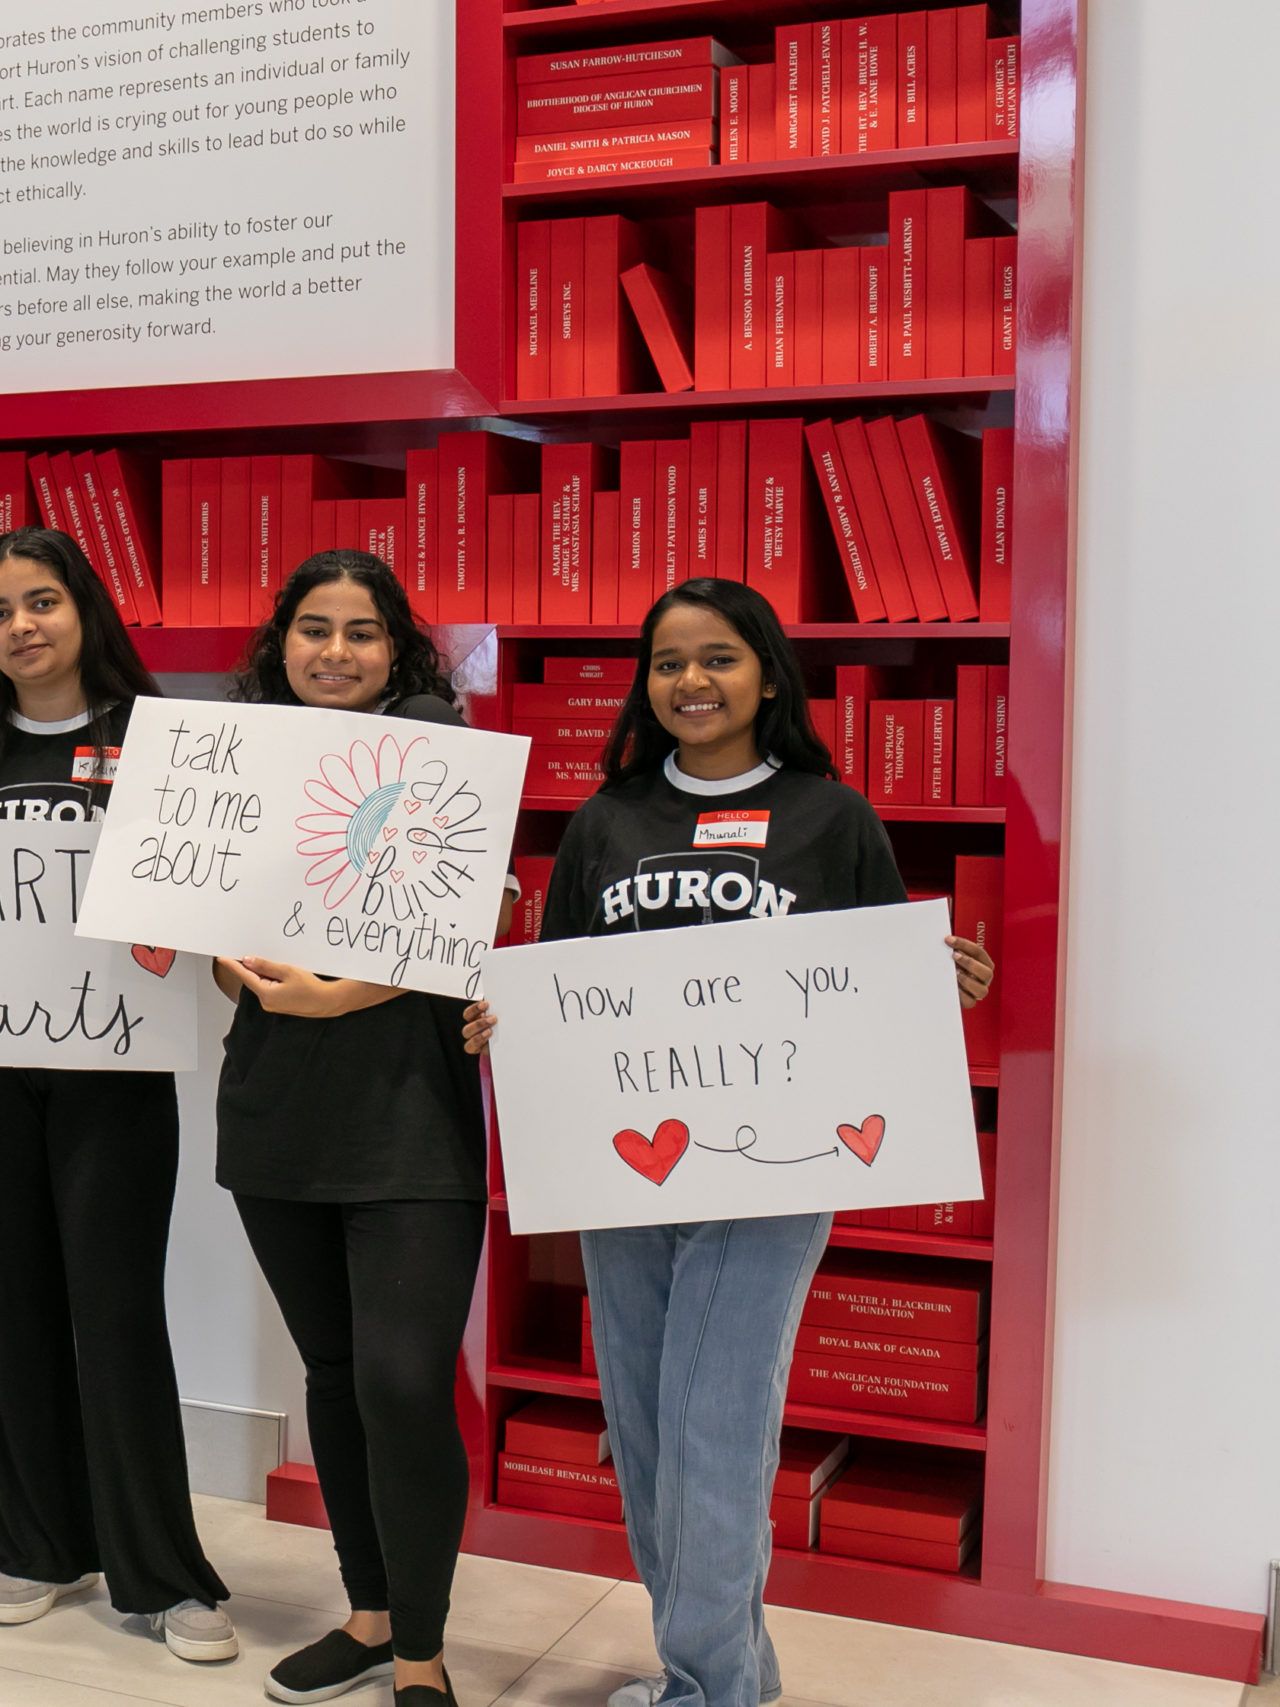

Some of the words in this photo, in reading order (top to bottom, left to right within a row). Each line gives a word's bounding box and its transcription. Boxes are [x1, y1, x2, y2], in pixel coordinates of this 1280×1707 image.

[24, 89, 63, 108] Each
[68, 86, 114, 103] name
[119, 72, 209, 99] represents
[214, 71, 235, 86] an
[241, 56, 324, 83] individual
[330, 58, 349, 72] or
[355, 48, 410, 70] family
[550, 59, 580, 71] SUSAN
[582, 49, 682, 67] FARROW-HUTCHESON
[16, 123, 42, 140] the
[47, 116, 92, 136] world
[97, 115, 110, 131] is
[115, 110, 167, 132] crying
[172, 104, 200, 123] out
[205, 102, 229, 119] for
[234, 98, 288, 120] young
[294, 88, 354, 114] people
[359, 83, 397, 102] who
[527, 95, 589, 108] BROTHERHOOD
[590, 93, 602, 102] OF
[604, 89, 647, 101] ANGLICAN
[648, 84, 702, 97] CHURCHMEN
[573, 103, 608, 113] DIOCESE
[610, 102, 622, 110] OF
[624, 99, 653, 109] HURON
[0, 156, 26, 173] the
[31, 147, 117, 170] knowledge
[122, 141, 153, 160] and
[158, 137, 200, 157] skills
[205, 135, 223, 152] to
[228, 129, 264, 149] lead
[270, 126, 299, 145] but
[304, 123, 327, 141] do
[332, 124, 353, 139] so
[359, 115, 406, 136] while
[534, 142, 568, 153] DANIEL
[570, 139, 600, 150] SMITH
[602, 138, 609, 147] &
[612, 134, 655, 146] PATRICIA
[657, 130, 690, 141] MASON
[546, 167, 575, 178] JOYCE
[577, 166, 585, 175] &
[587, 163, 618, 174] DARCY
[620, 158, 673, 170] MCKEOUGH
[16, 180, 86, 202] ethically.
[529, 268, 538, 311] MEDLINE
[775, 276, 784, 335] FERNANDES
[529, 313, 538, 356] MICHAEL
[563, 302, 571, 339] SOBEYS
[775, 337, 784, 368] BRIAN
[633, 498, 641, 529] ORSER
[922, 476, 942, 523] WARAICH
[935, 524, 953, 561] FAMILY
[996, 487, 1005, 529] DONALD
[201, 538, 209, 584] PRUDENCE
[632, 531, 640, 569] MARION
[995, 532, 1005, 564] ALLAN
[845, 696, 854, 744] THOMSON
[168, 719, 242, 776] talk
[845, 746, 853, 774] MARY
[154, 776, 195, 827] to
[208, 789, 261, 835] me
[717, 812, 750, 820] HELLO
[131, 830, 242, 892] about
[602, 869, 798, 929] HURON
[283, 900, 306, 938] &
[326, 914, 488, 1000] everything
[553, 973, 634, 1024] how
[682, 974, 742, 1008] are
[812, 1290, 832, 1300] THE
[837, 1292, 878, 1305] WALTER
[892, 1298, 951, 1313] BLACKBURN
[850, 1304, 914, 1319] FOUNDATION
[819, 1336, 851, 1348] ROYAL
[853, 1340, 881, 1352] BANK
[883, 1344, 897, 1353] OF
[899, 1346, 941, 1358] CANADA
[504, 1461, 554, 1476] MOBILEASE
[556, 1469, 597, 1483] RENTALS
